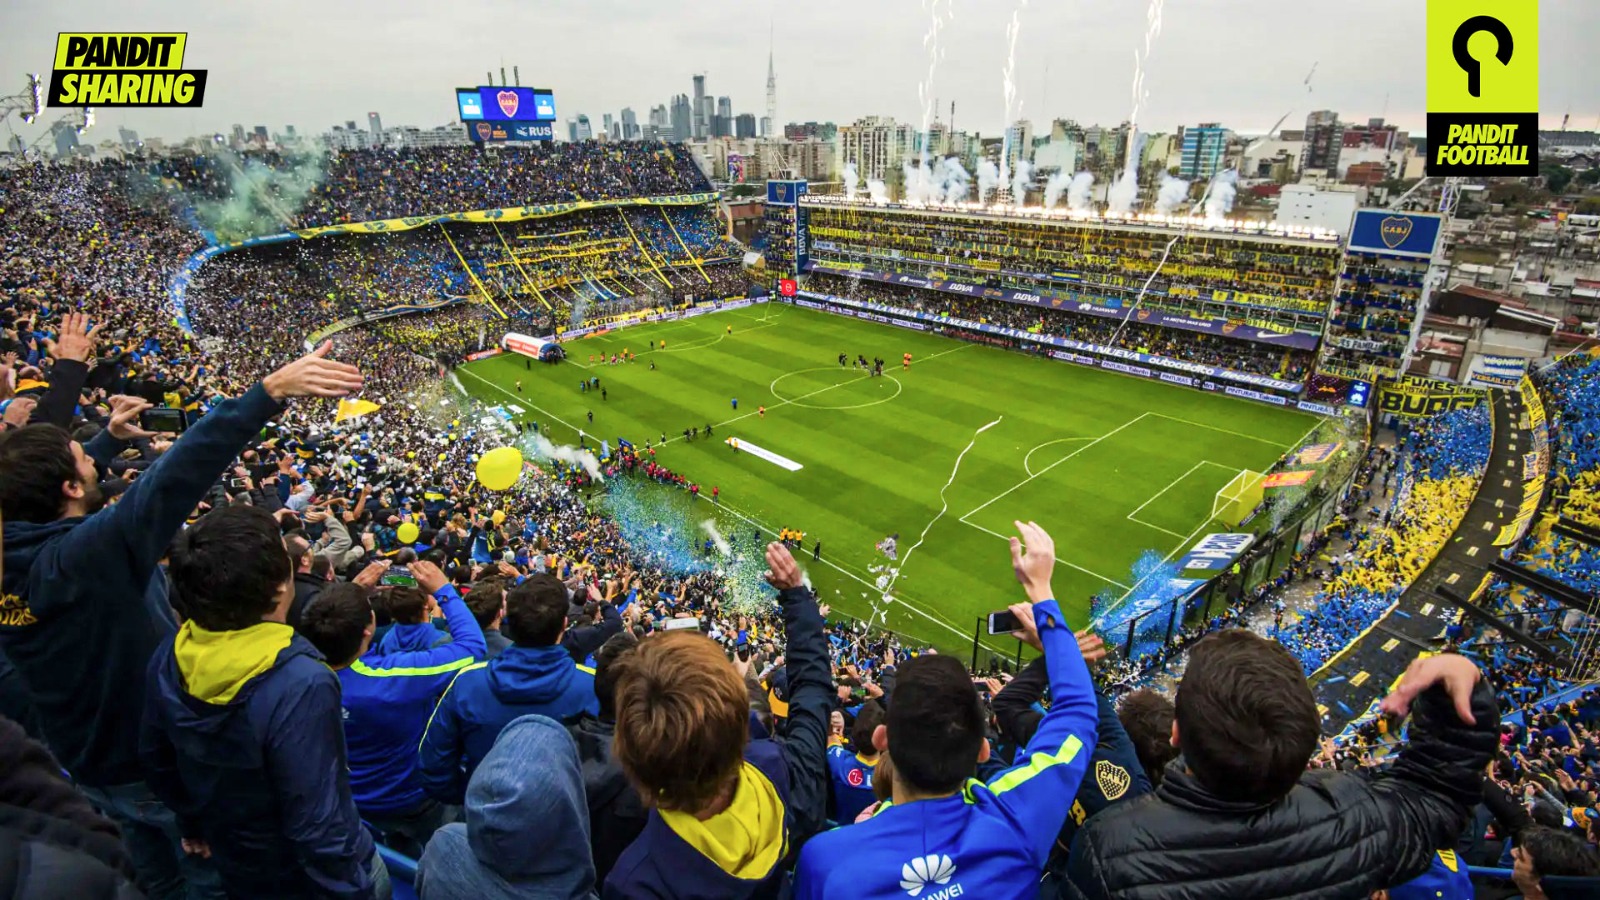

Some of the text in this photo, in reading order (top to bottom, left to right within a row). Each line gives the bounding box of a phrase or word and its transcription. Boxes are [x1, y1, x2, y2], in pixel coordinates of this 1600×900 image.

[528, 126, 552, 137] RUS
[948, 283, 973, 293] BBVA
[1013, 292, 1040, 303] BBVA
[947, 317, 981, 331] NUEVA
[1000, 328, 1055, 344] LA NUEVA
[1076, 342, 1141, 361] LA NUEVA
[1102, 361, 1128, 372] PINTURAS
[1162, 373, 1190, 385] PINTURAS
[1402, 375, 1456, 393] FUNES
[1227, 386, 1257, 399] PINTURAS
